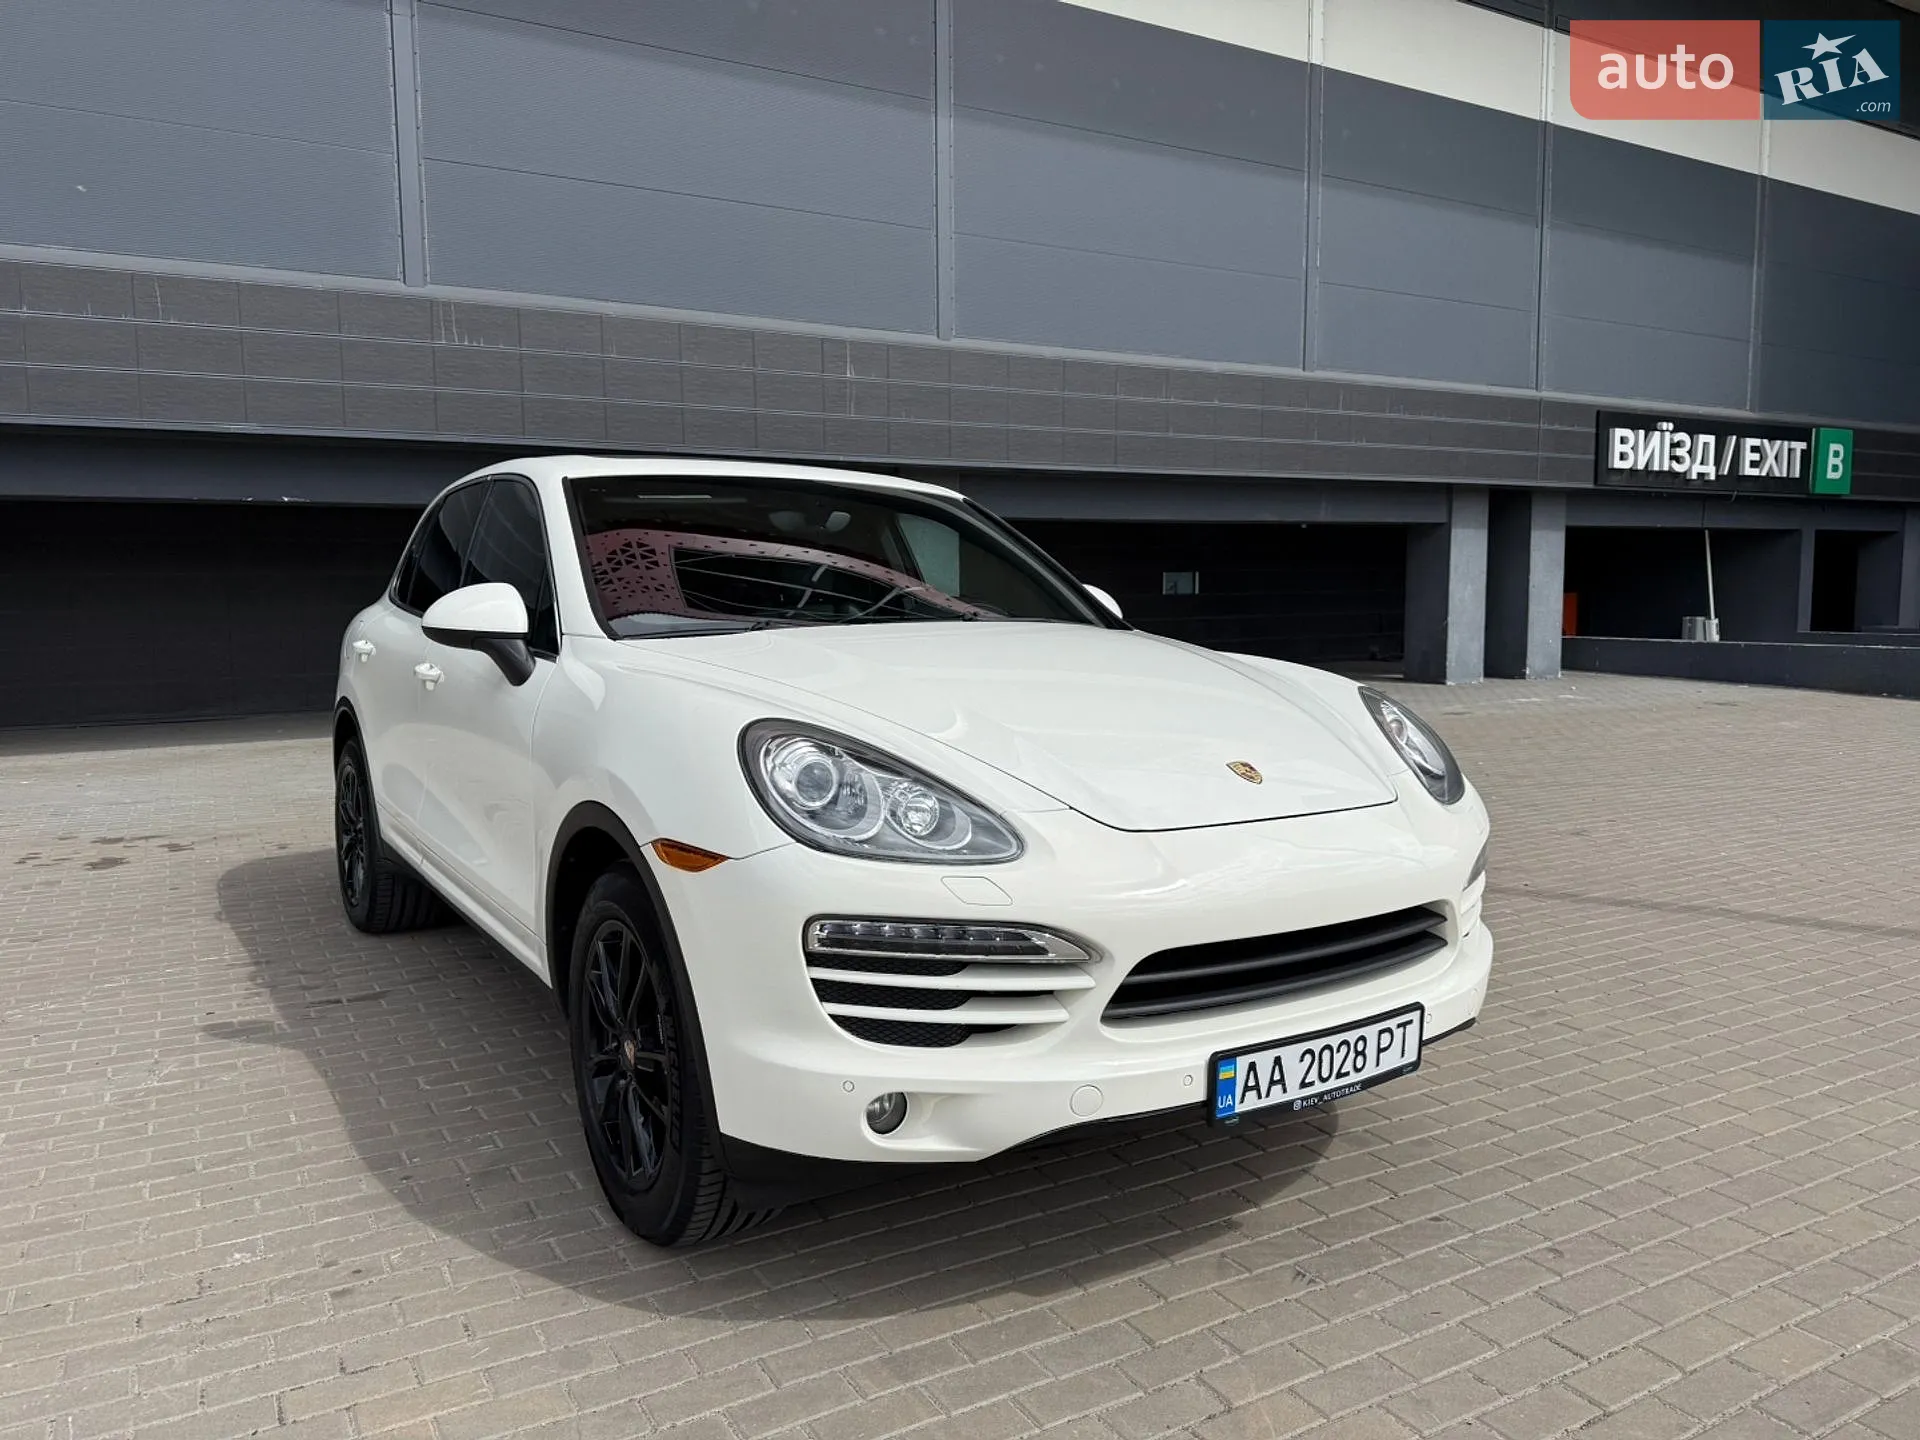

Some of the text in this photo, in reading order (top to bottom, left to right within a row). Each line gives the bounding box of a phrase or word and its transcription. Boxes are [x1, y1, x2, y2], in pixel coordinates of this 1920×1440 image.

[1608, 421, 1716, 480] ВИЇЗД
[1739, 437, 1808, 478] EXIT
[1239, 1018, 1414, 1104] AA 2028 PT
[1217, 1096, 1233, 1109] UA
